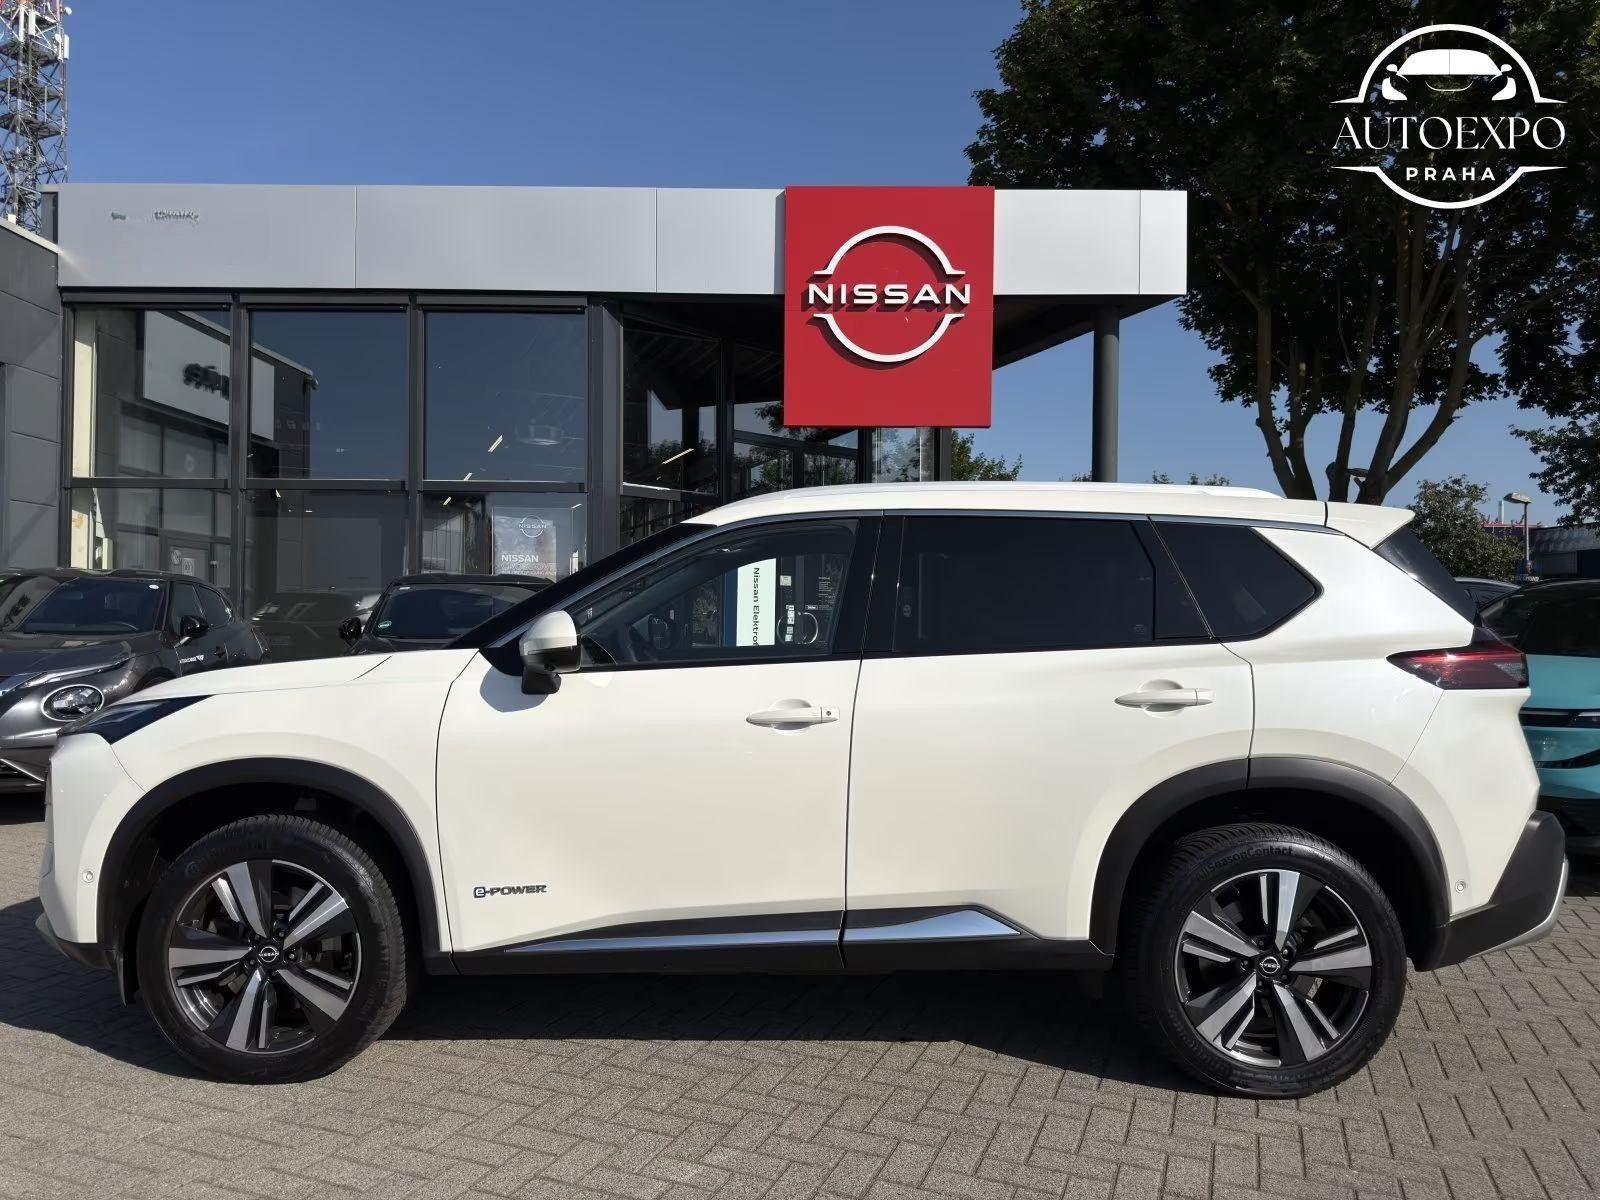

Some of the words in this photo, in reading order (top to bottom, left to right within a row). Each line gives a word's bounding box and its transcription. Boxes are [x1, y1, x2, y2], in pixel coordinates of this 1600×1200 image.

[808, 283, 971, 305] NISSAN
[501, 554, 539, 563] NISSAN
[753, 567, 761, 603] Nissan
[473, 884, 547, 898] e-POWER
